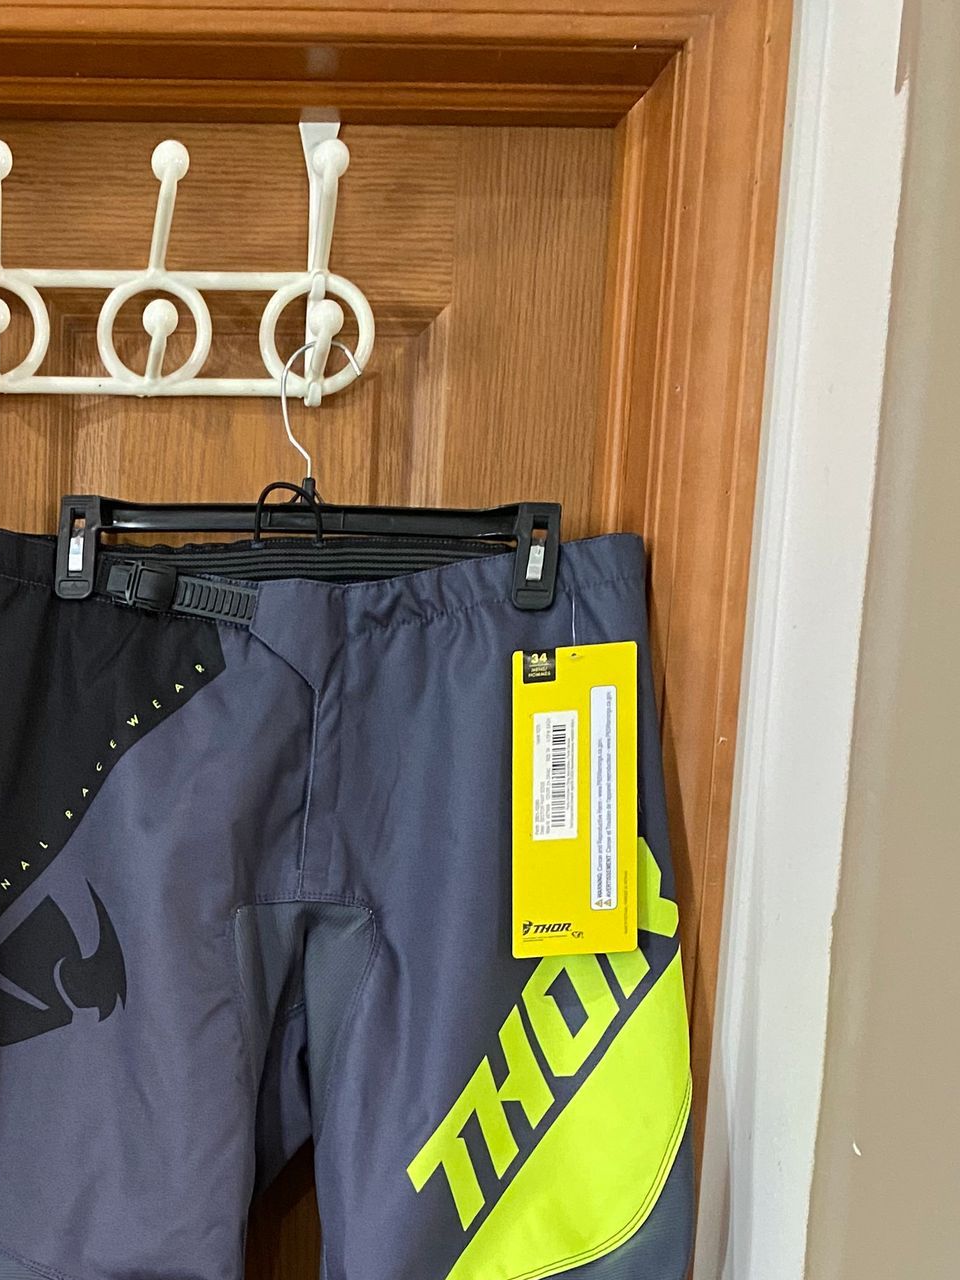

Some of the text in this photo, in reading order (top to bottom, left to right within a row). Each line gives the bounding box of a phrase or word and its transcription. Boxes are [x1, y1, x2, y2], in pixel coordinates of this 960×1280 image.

[531, 652, 548, 664] 34
[64, 664, 205, 819] RACEWEAR
[533, 922, 572, 934] THOR
